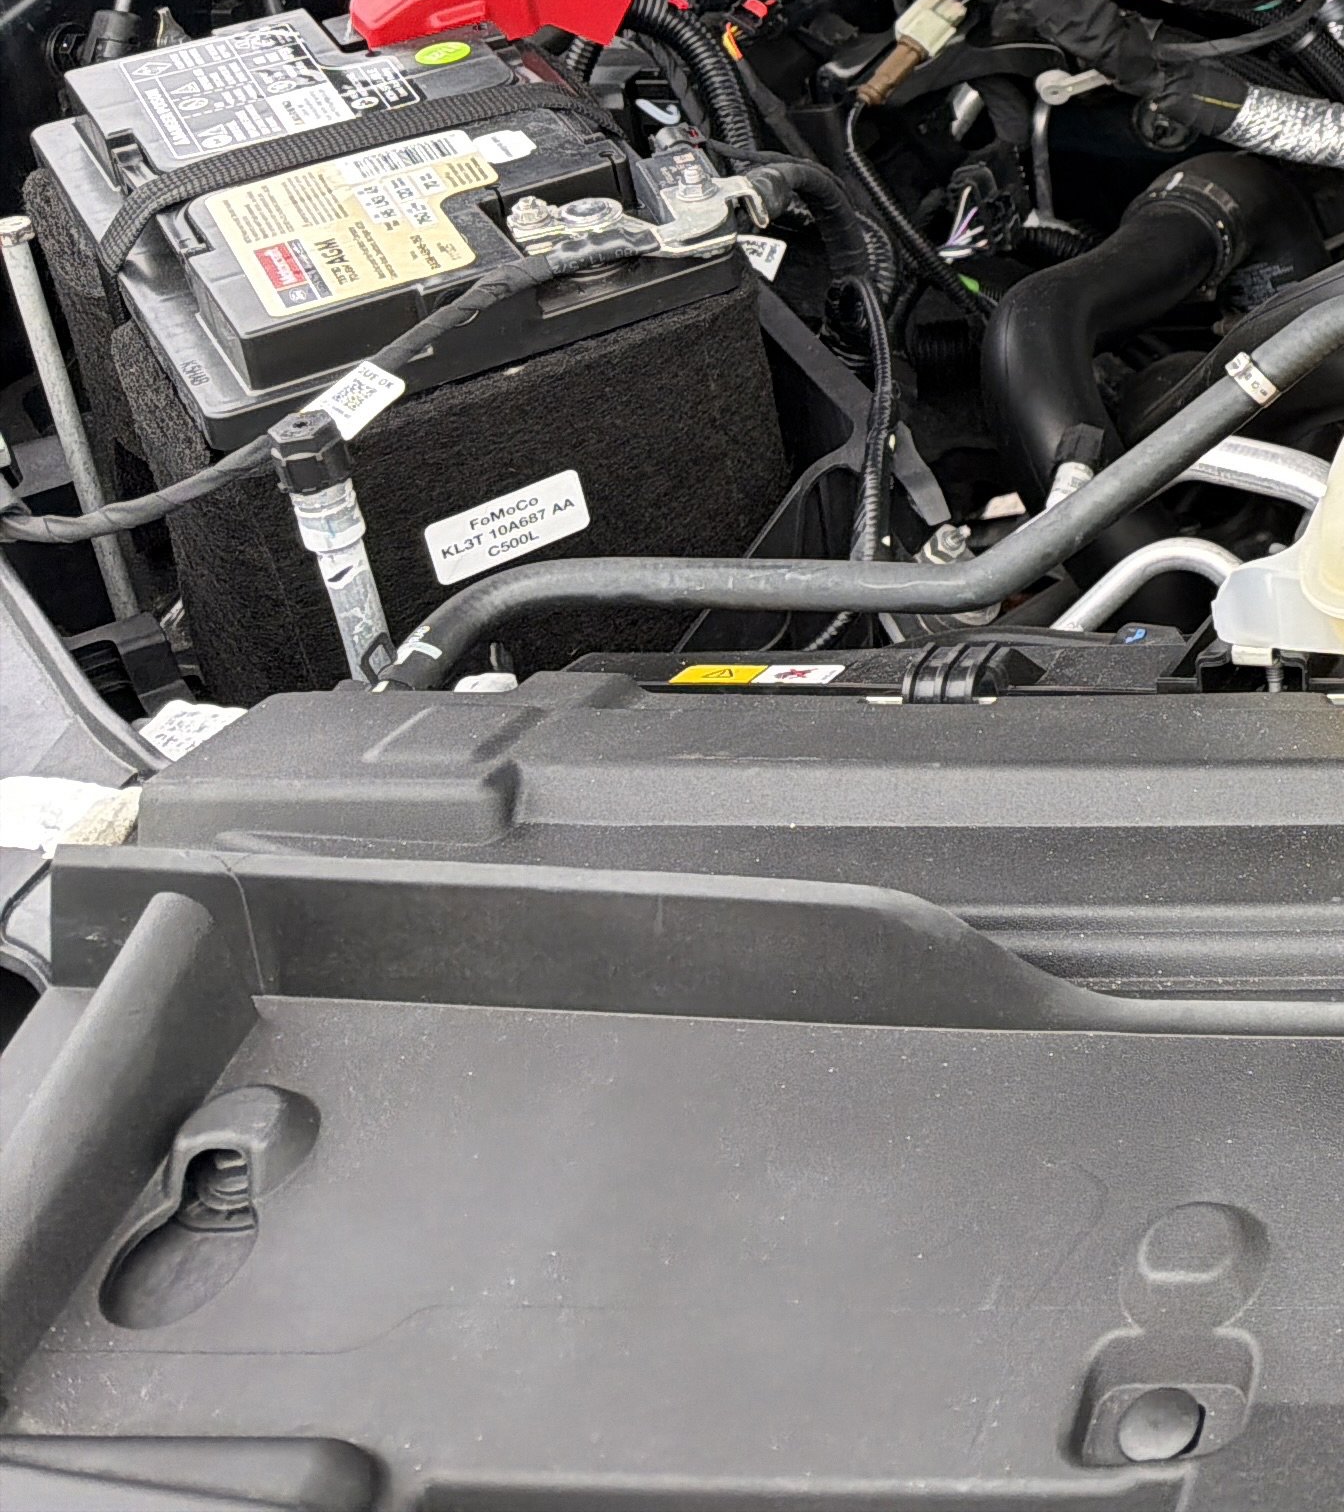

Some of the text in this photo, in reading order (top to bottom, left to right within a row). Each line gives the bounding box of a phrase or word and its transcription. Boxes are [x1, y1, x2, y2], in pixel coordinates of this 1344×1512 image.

[314, 237, 348, 266] AGM
[441, 498, 575, 559] KL3T 10A687 AA
[469, 497, 539, 530] FoMoCo
[488, 531, 540, 557] C500L
